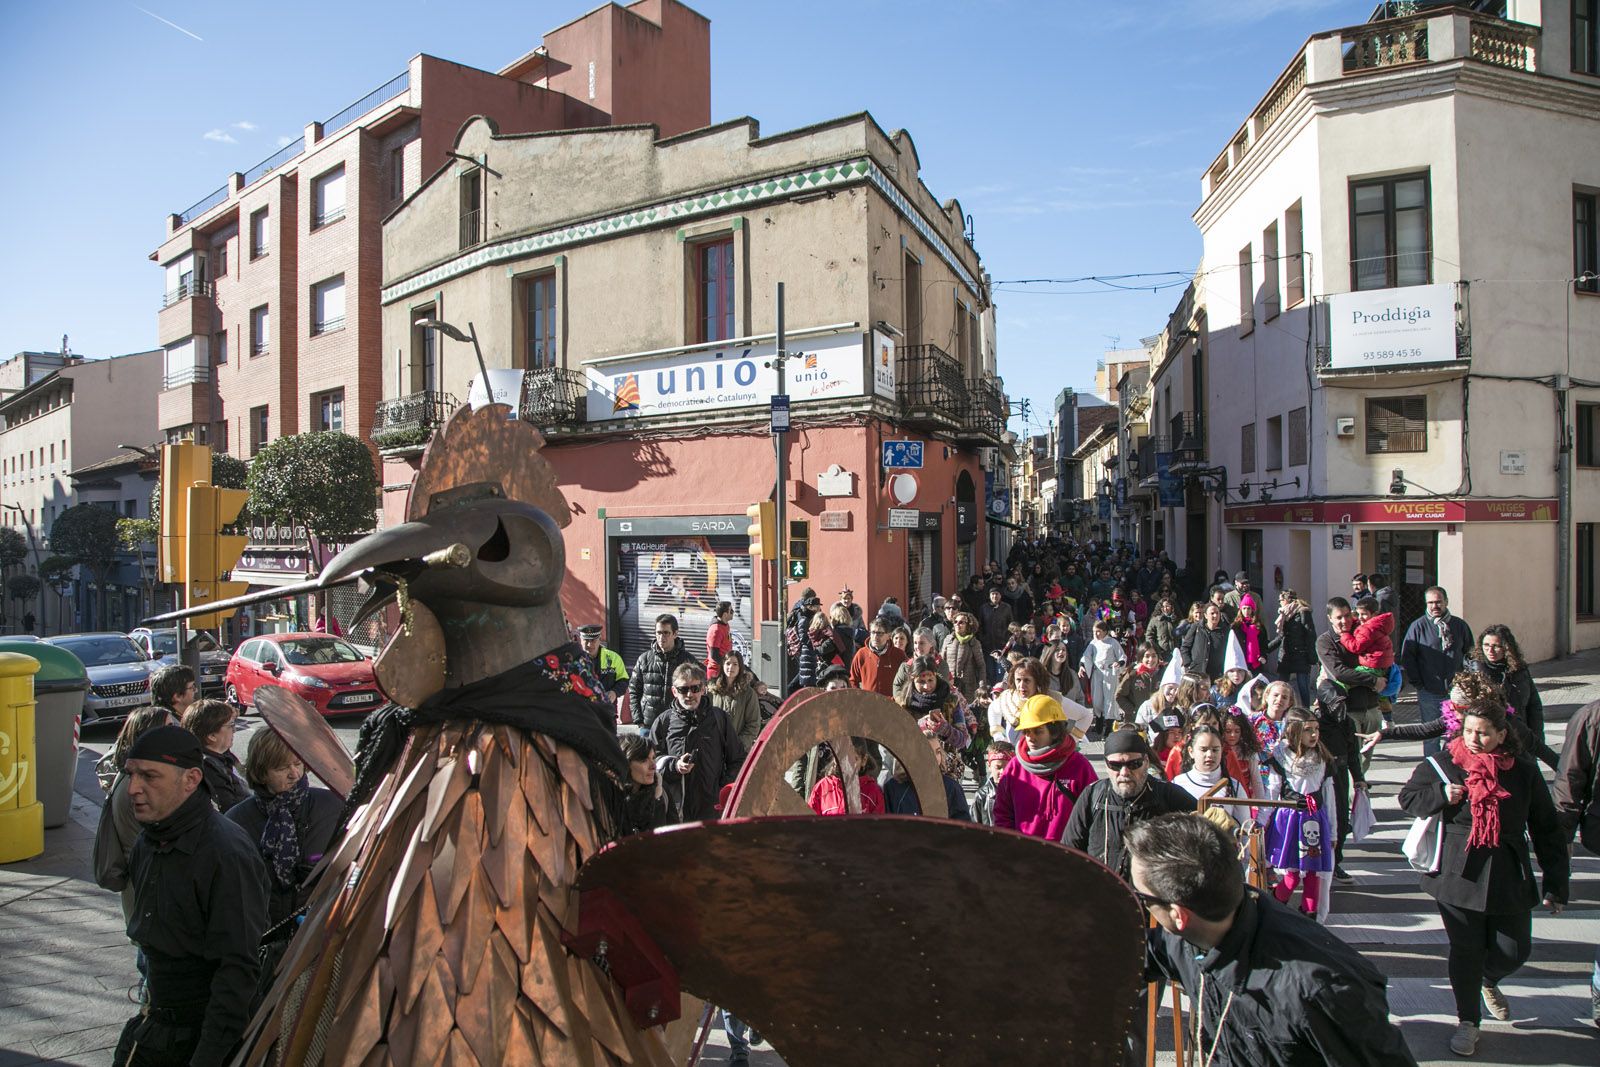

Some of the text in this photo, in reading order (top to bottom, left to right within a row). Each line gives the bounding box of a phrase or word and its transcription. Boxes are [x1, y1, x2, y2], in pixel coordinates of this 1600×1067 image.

[1352, 306, 1432, 325] Proddigia
[1363, 348, 1423, 361] 93 589 45 36
[656, 349, 757, 396] unió
[795, 368, 828, 383] unió
[717, 391, 757, 404] Catalunya
[1383, 503, 1446, 514] VIATGES
[1486, 502, 1526, 513] VIATGES
[691, 518, 736, 531] SARDÀ
